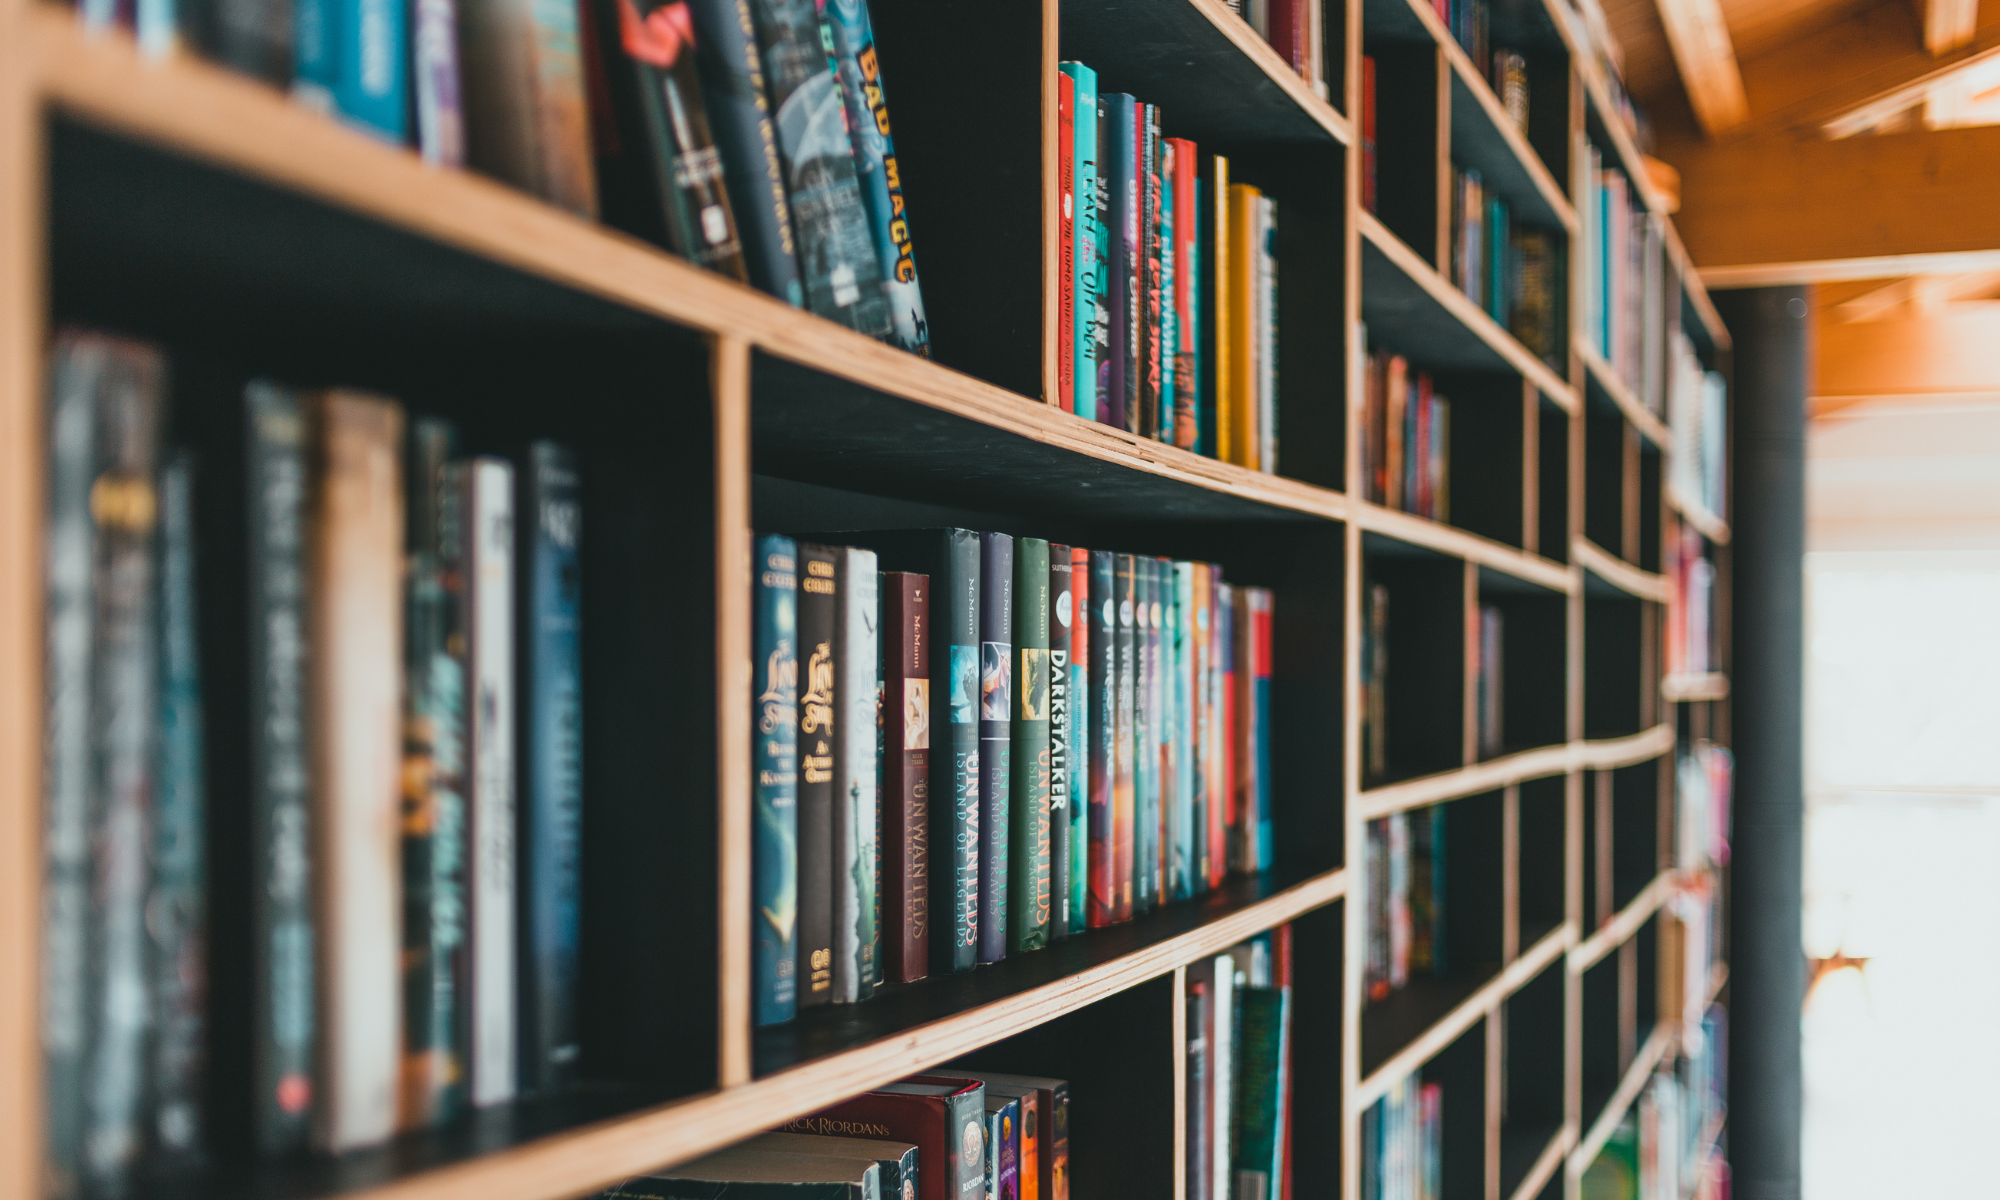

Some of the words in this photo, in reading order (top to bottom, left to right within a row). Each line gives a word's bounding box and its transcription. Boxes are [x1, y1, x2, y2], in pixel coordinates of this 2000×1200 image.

[858, 44, 890, 137] BAD
[884, 153, 915, 285] MAGIC
[1064, 339, 1072, 387] AGENDA
[968, 577, 976, 635] McMann
[1003, 578, 1011, 635] McMann
[914, 614, 922, 669] McMann
[1050, 649, 1067, 811] DARKSTALKER
[956, 751, 967, 821] ISLAND
[990, 767, 1001, 823] ISLAND
[1028, 761, 1038, 815] ISLAND
[906, 800, 914, 856] ISLAND
[956, 831, 967, 856] OF
[965, 754, 980, 948] UNWANTEDS
[990, 829, 1000, 849] OF
[1028, 820, 1038, 840] OF
[1036, 750, 1050, 927] UNWANTEDS
[906, 862, 914, 879] OF
[912, 785, 929, 941] UNWANTEDS
[990, 854, 1000, 916] GRAVES
[1028, 845, 1038, 914] DRAGONS
[906, 889, 914, 925] FIRE
[956, 865, 967, 949] LEGENDS
